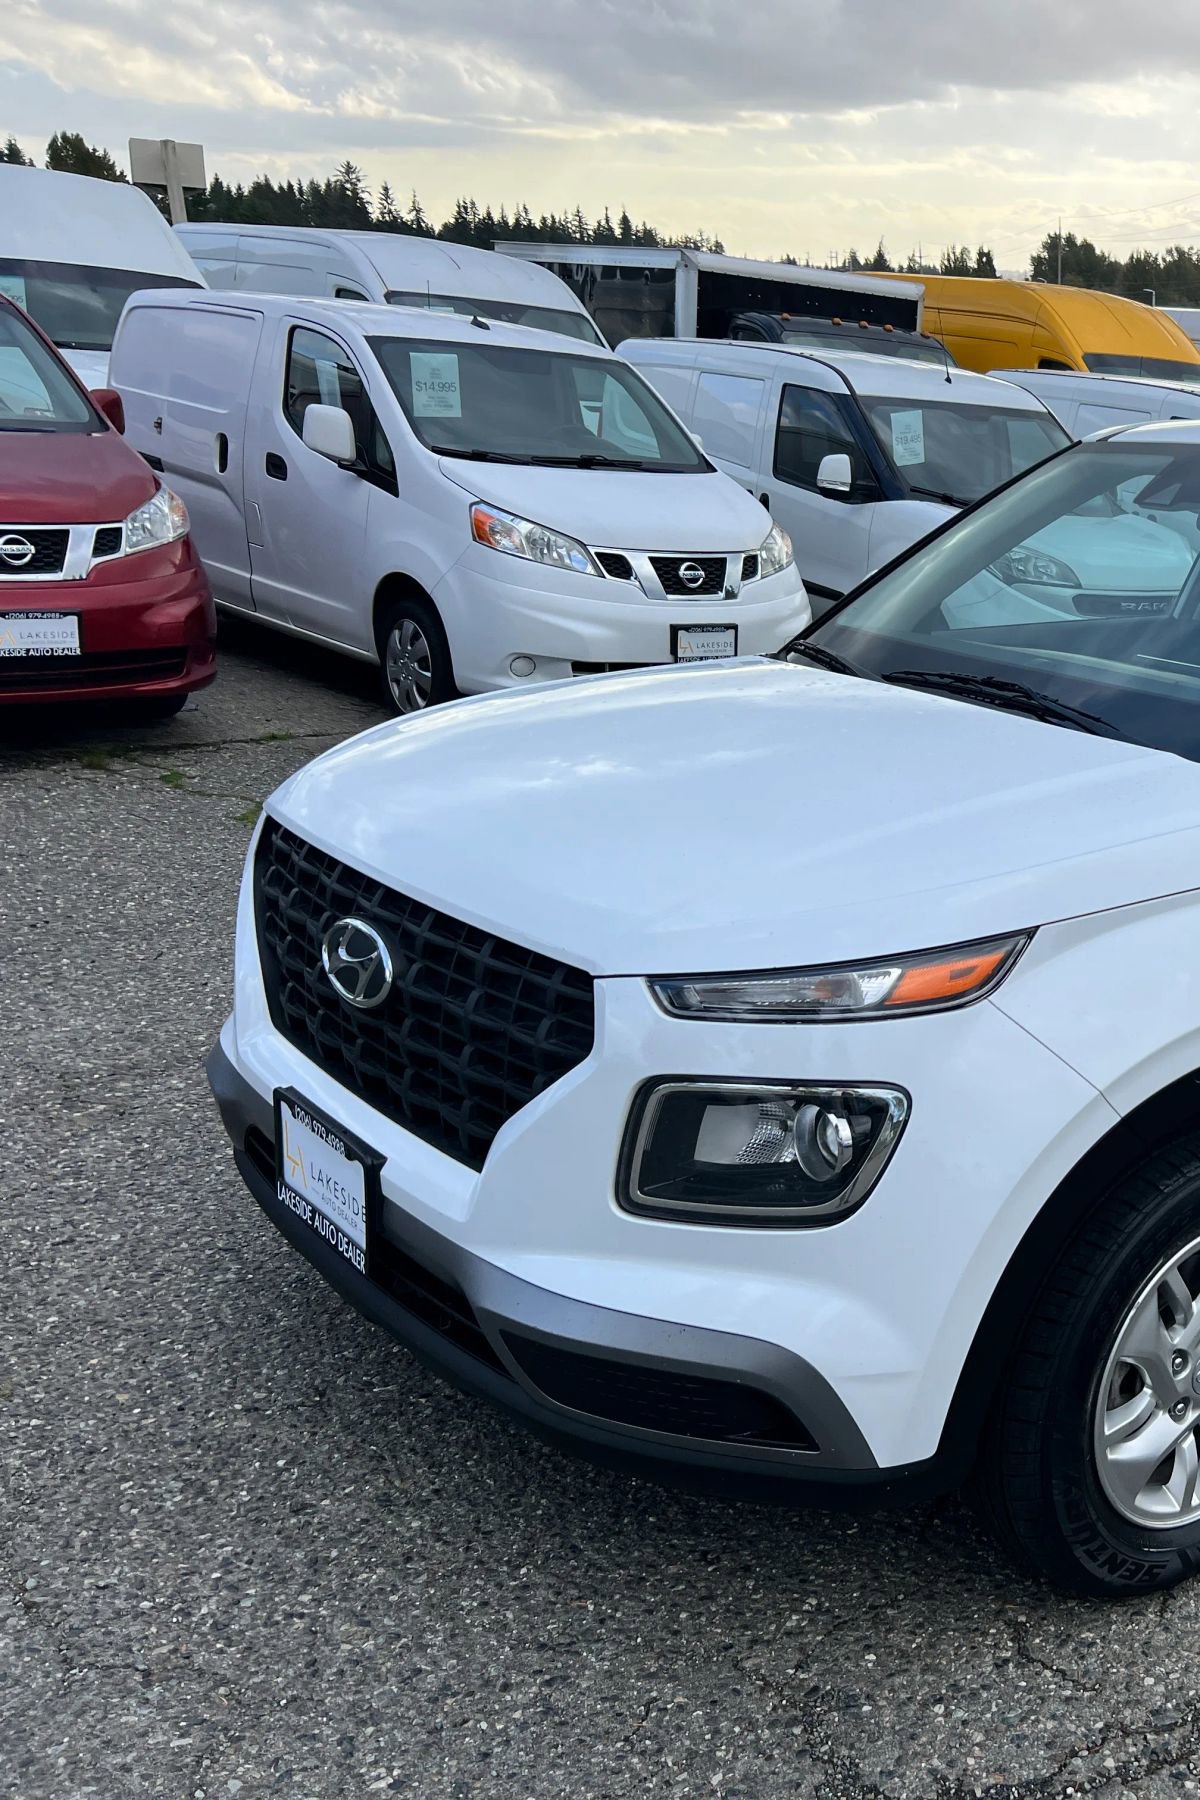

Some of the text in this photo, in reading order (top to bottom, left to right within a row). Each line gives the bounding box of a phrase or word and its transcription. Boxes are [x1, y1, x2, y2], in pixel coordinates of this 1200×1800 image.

[19, 631, 76, 640] LAKESIDE
[697, 641, 733, 649] LAKESIDE
[0, 647, 81, 657] KESIDE AUTO DEALER
[311, 1162, 367, 1223] LAKESIDE
[277, 1181, 366, 1275] LAKESIDE AUTO DEALER
